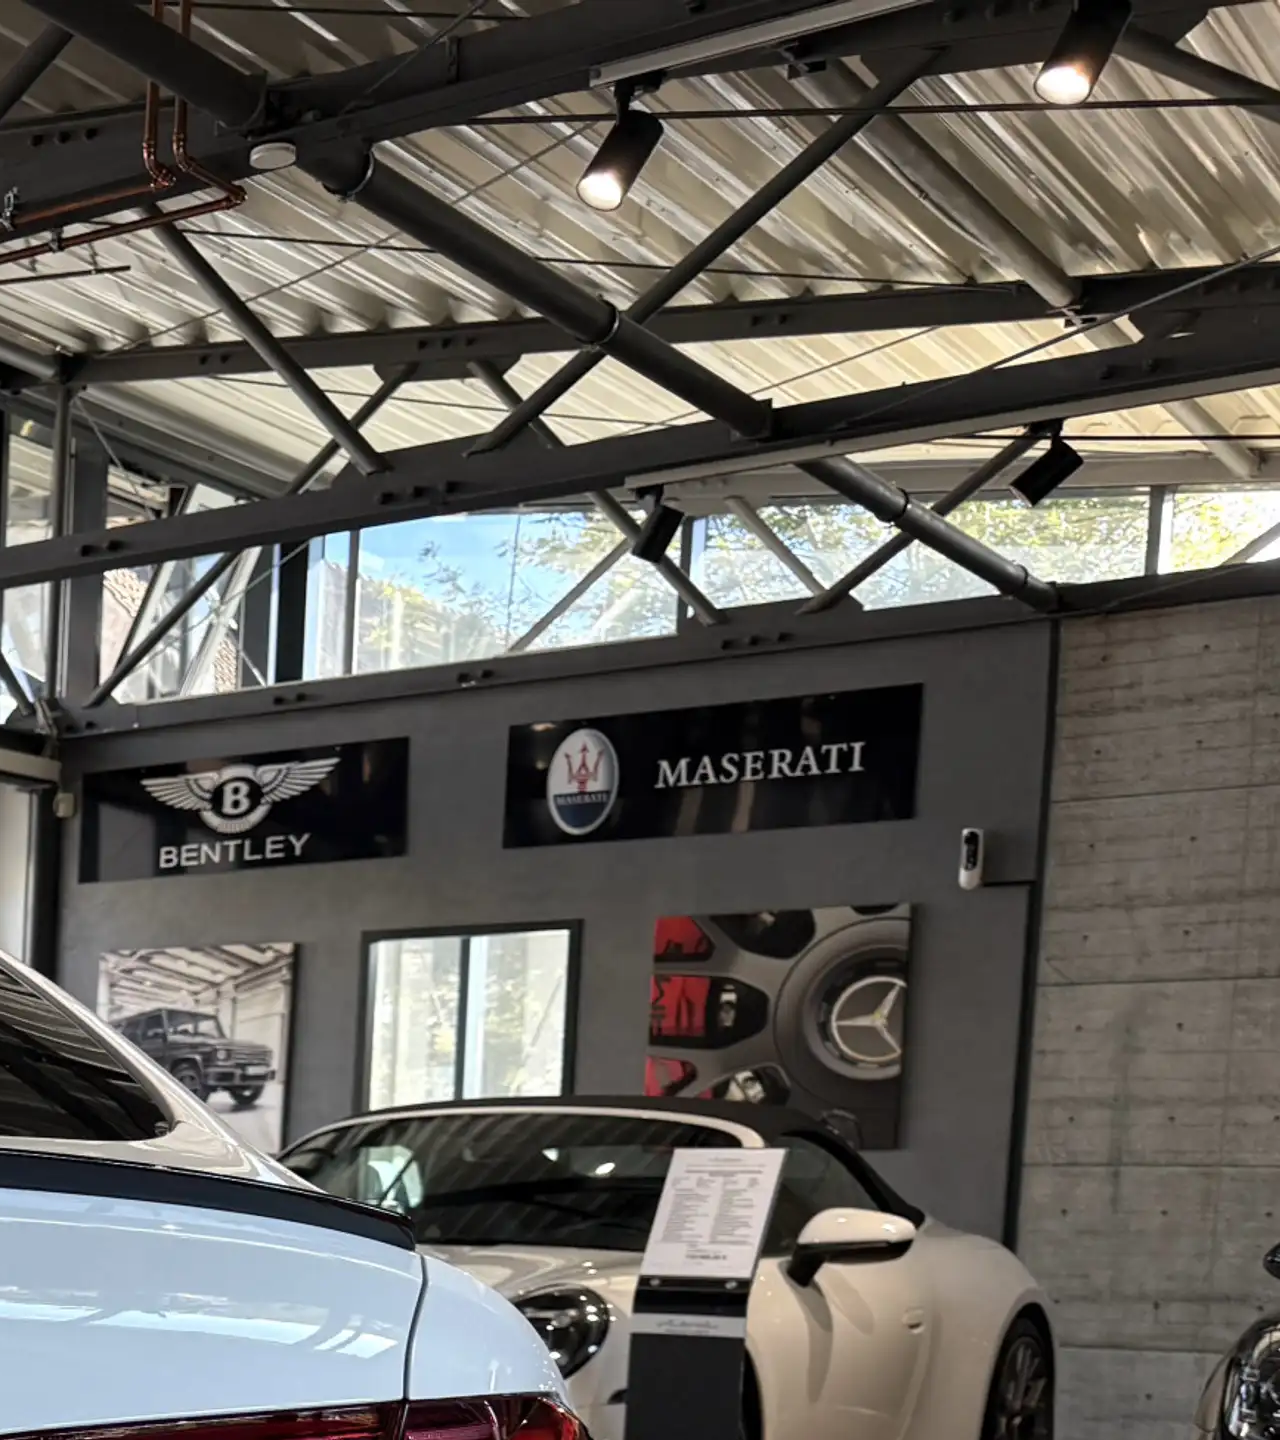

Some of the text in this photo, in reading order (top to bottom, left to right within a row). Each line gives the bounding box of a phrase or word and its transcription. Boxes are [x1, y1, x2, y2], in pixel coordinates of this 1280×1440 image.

[654, 741, 866, 789] MASERATI
[222, 781, 250, 816] B
[158, 832, 311, 869] BENTLEY
